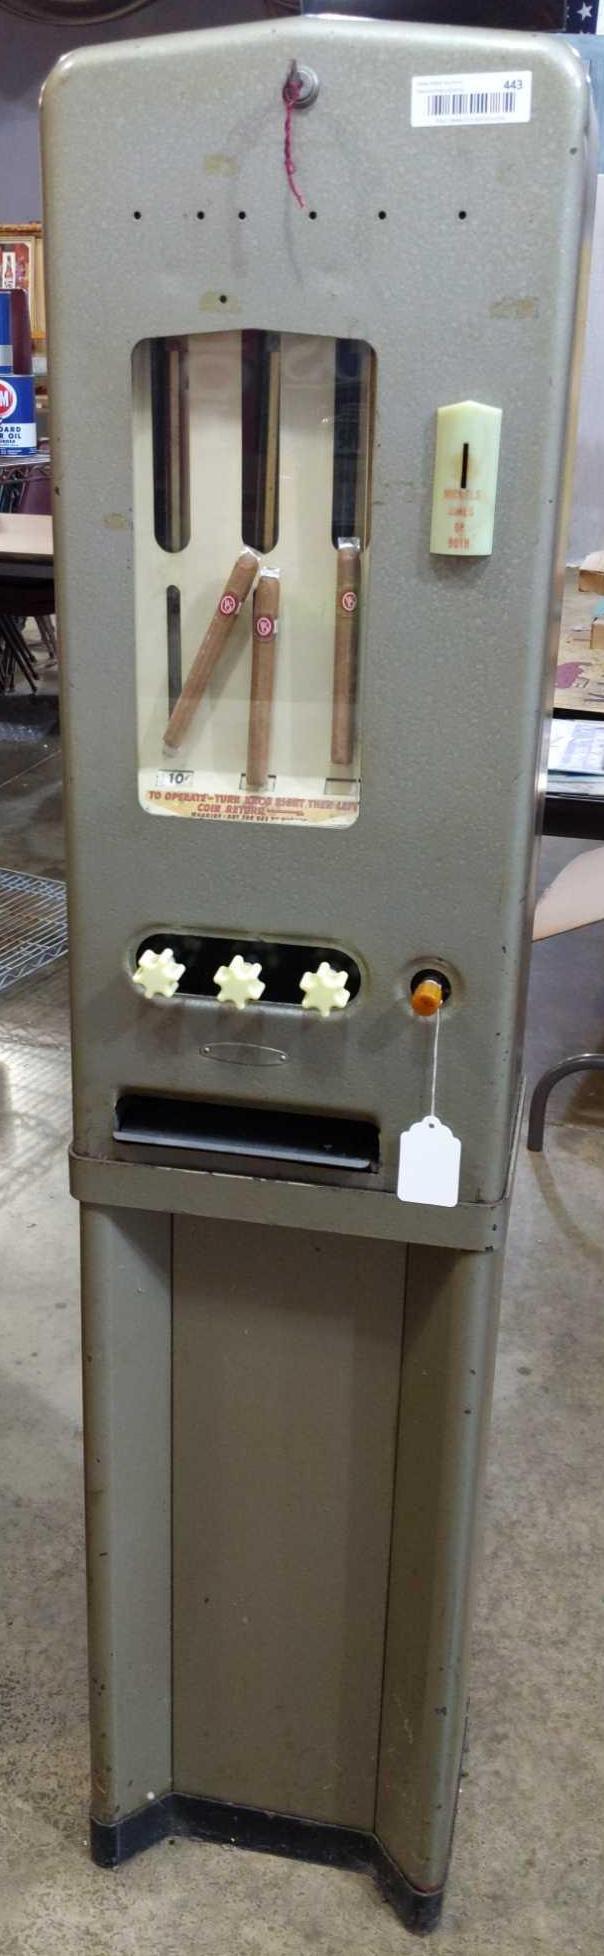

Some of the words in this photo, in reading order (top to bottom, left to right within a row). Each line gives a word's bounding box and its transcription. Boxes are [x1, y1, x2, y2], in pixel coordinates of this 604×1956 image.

[503, 80, 523, 89] 443
[149, 790, 161, 800] TO
[198, 803, 221, 812] COIN
